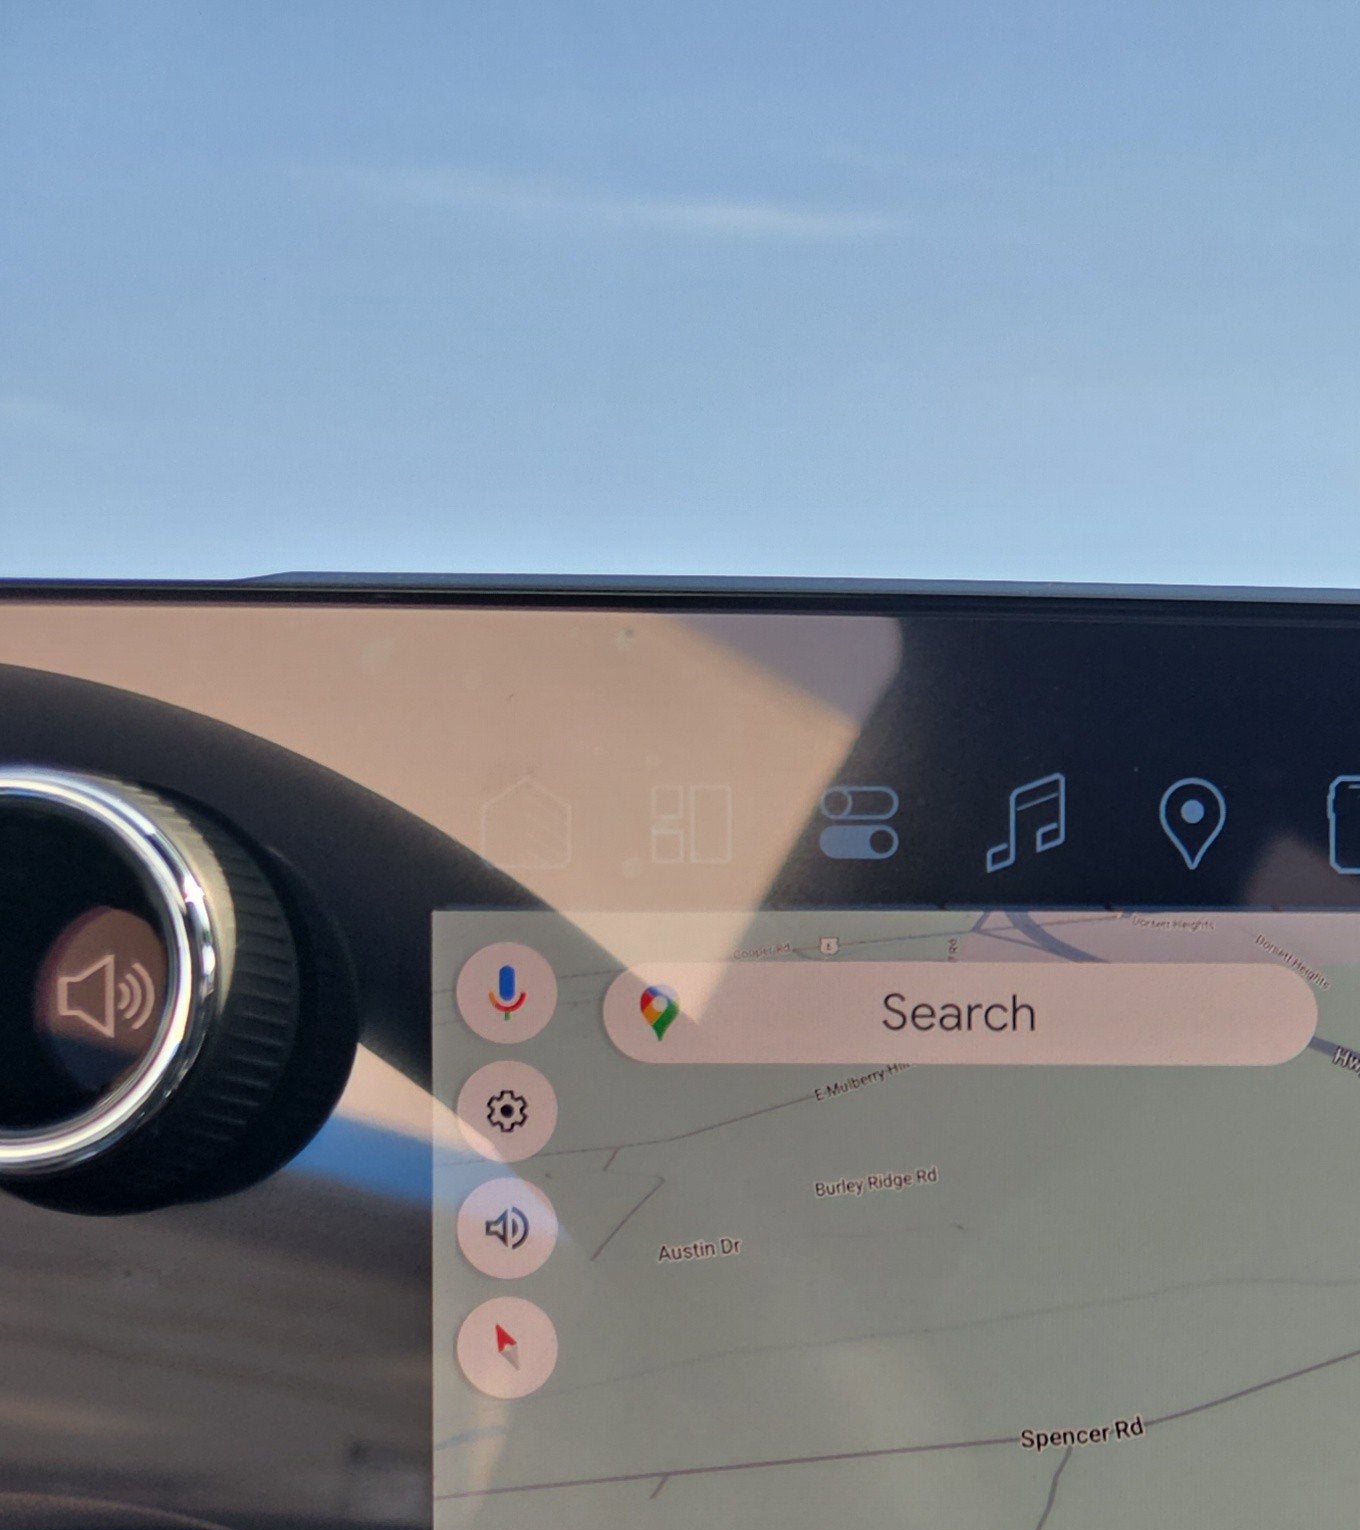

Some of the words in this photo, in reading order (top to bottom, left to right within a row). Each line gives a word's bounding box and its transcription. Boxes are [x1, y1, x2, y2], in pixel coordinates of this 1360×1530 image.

[882, 993, 1036, 1032] Search
[814, 1088, 824, 1101] E
[826, 1069, 886, 1097] Mulberry
[814, 1178, 864, 1198] Burley
[868, 1171, 913, 1193] Ridge
[916, 1166, 938, 1185] Rd
[658, 1239, 716, 1263] Austin
[719, 1237, 742, 1256] Dr
[1020, 1424, 1110, 1451] Spencer
[1112, 1417, 1144, 1440] Rd
